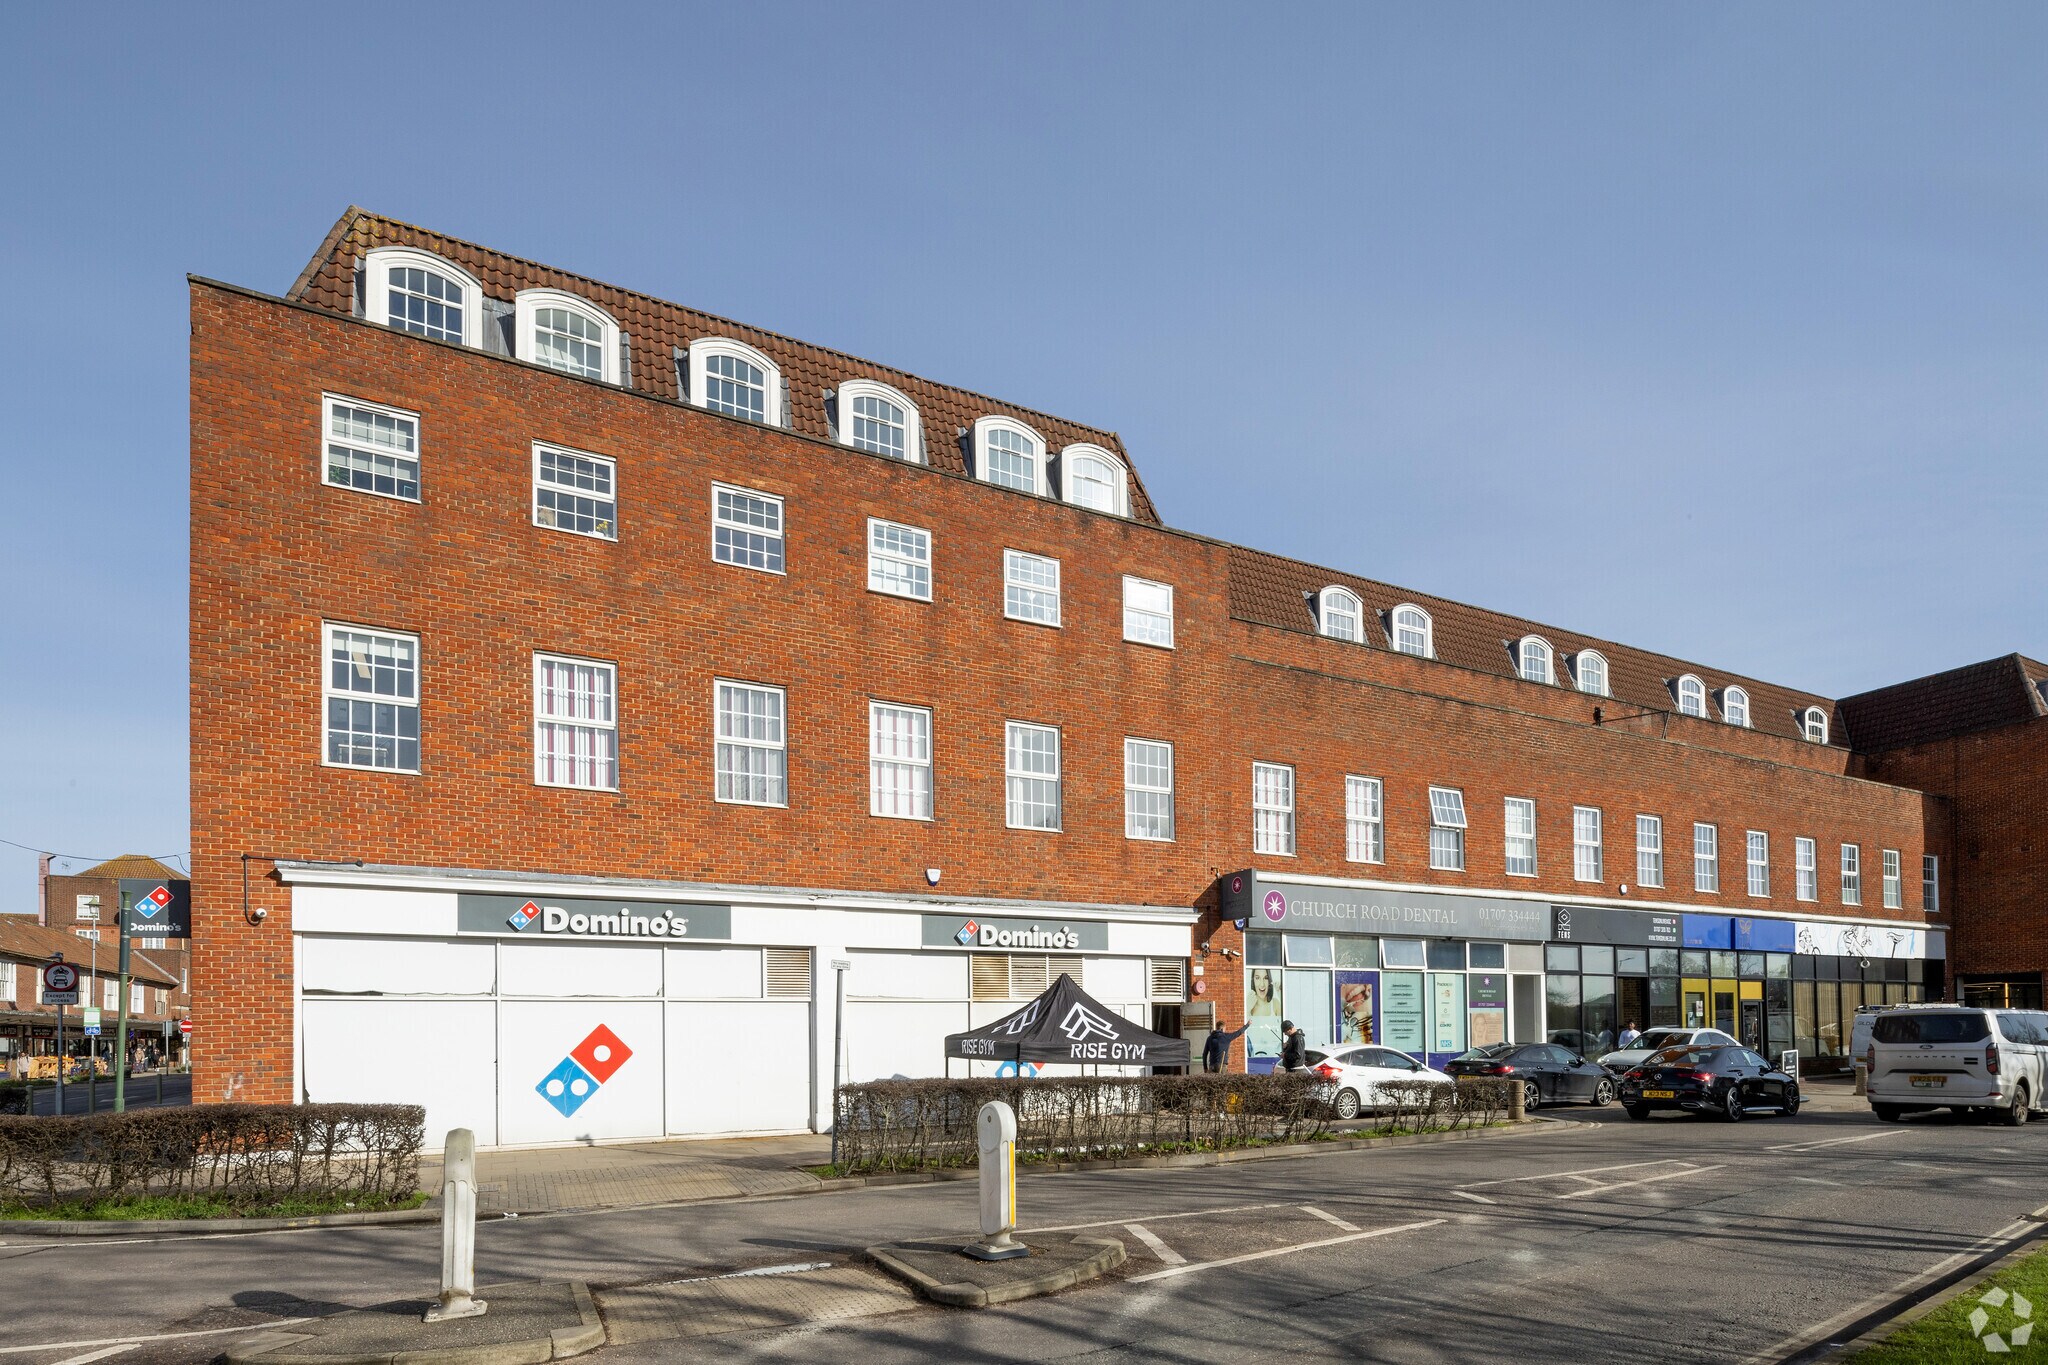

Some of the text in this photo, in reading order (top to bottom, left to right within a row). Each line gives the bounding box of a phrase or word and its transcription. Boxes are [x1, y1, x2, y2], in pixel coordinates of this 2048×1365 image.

[543, 906, 688, 936] Domino's
[1290, 900, 1458, 924] CHURCH ROAD DENTAL
[1479, 907, 1541, 923] 01707 334444
[980, 924, 1080, 948] Domino's
[961, 1039, 996, 1056] RISE GYM
[1070, 1042, 1146, 1060] RISE GYM
[1440, 1039, 1453, 1048] NHS
